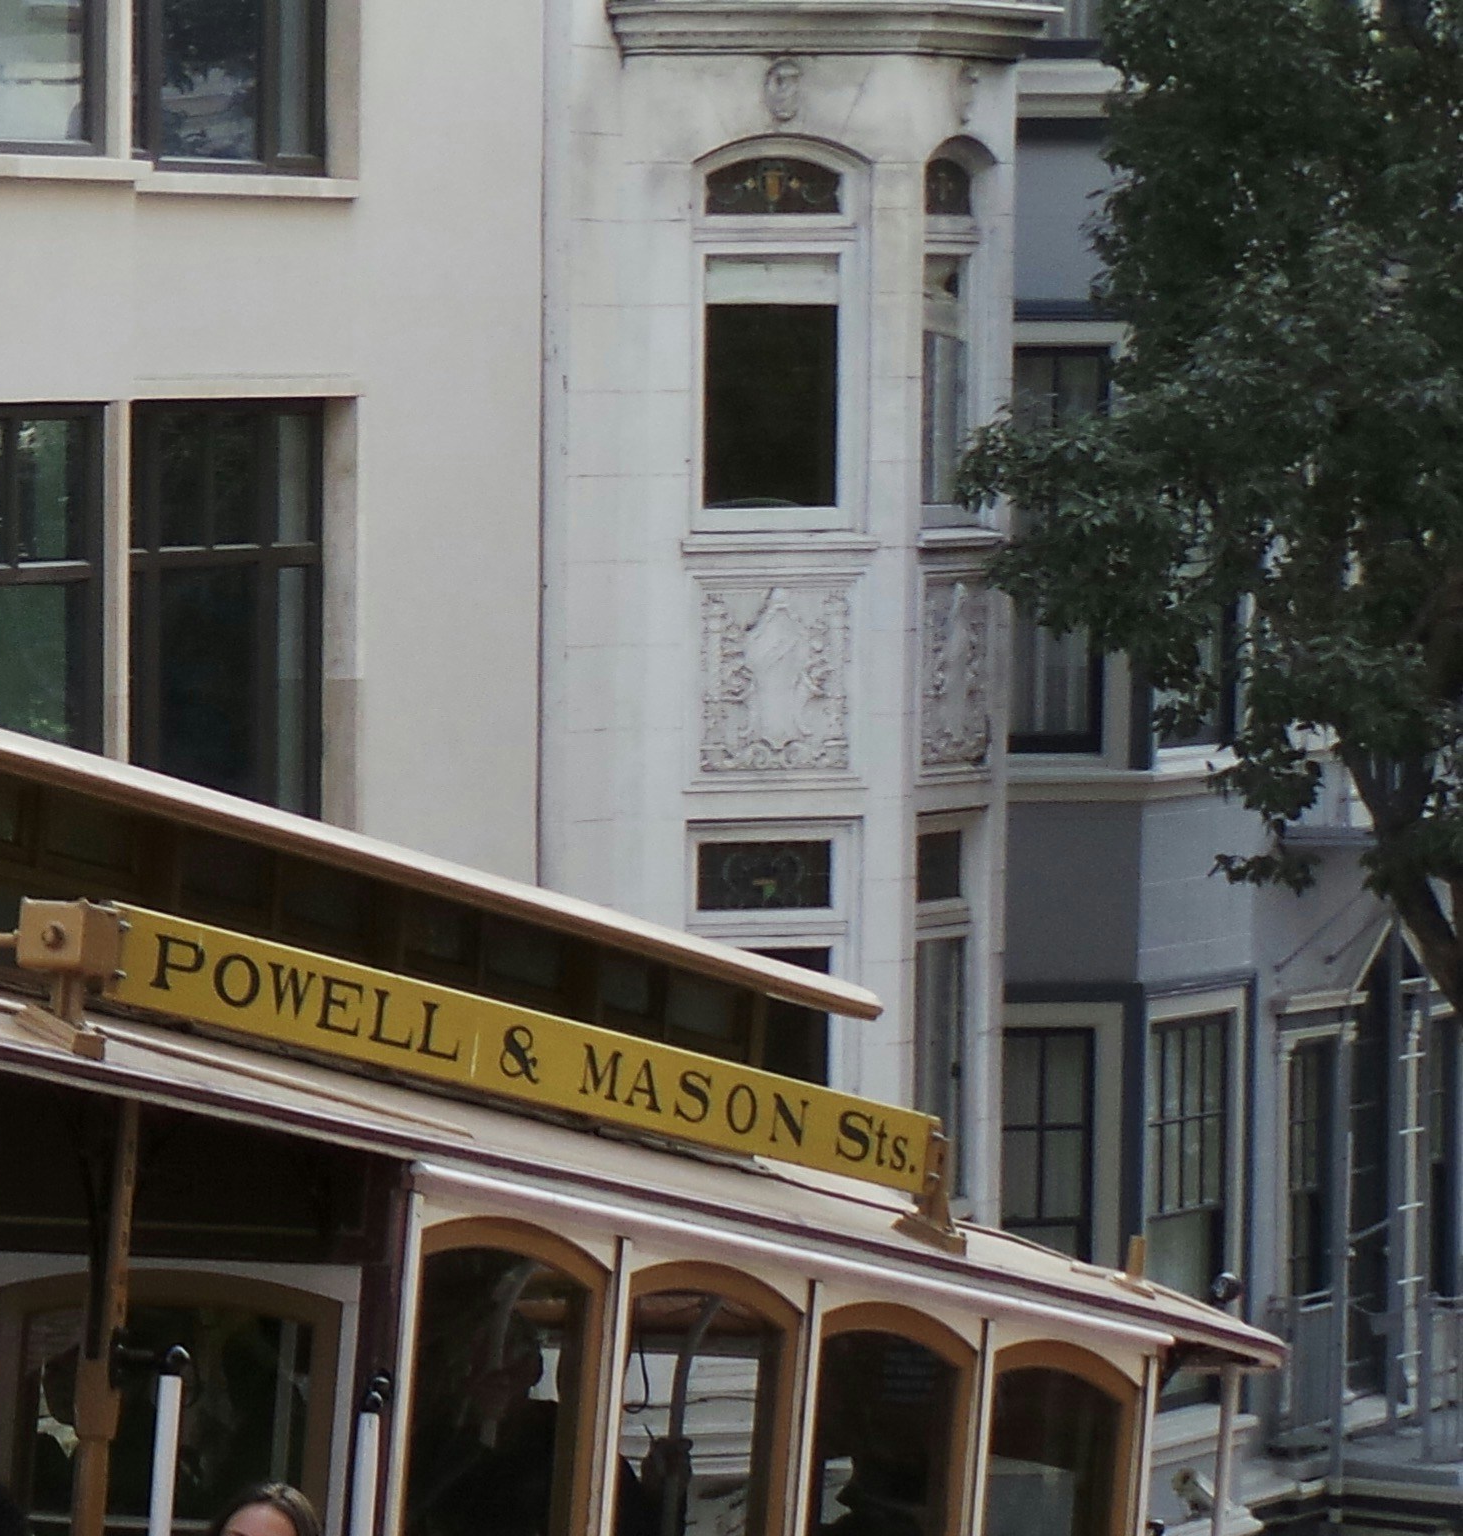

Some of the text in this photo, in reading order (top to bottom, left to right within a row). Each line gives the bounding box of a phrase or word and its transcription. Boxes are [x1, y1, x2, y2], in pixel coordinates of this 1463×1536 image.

[149, 932, 917, 1174] POWELL & MASON Sts.
